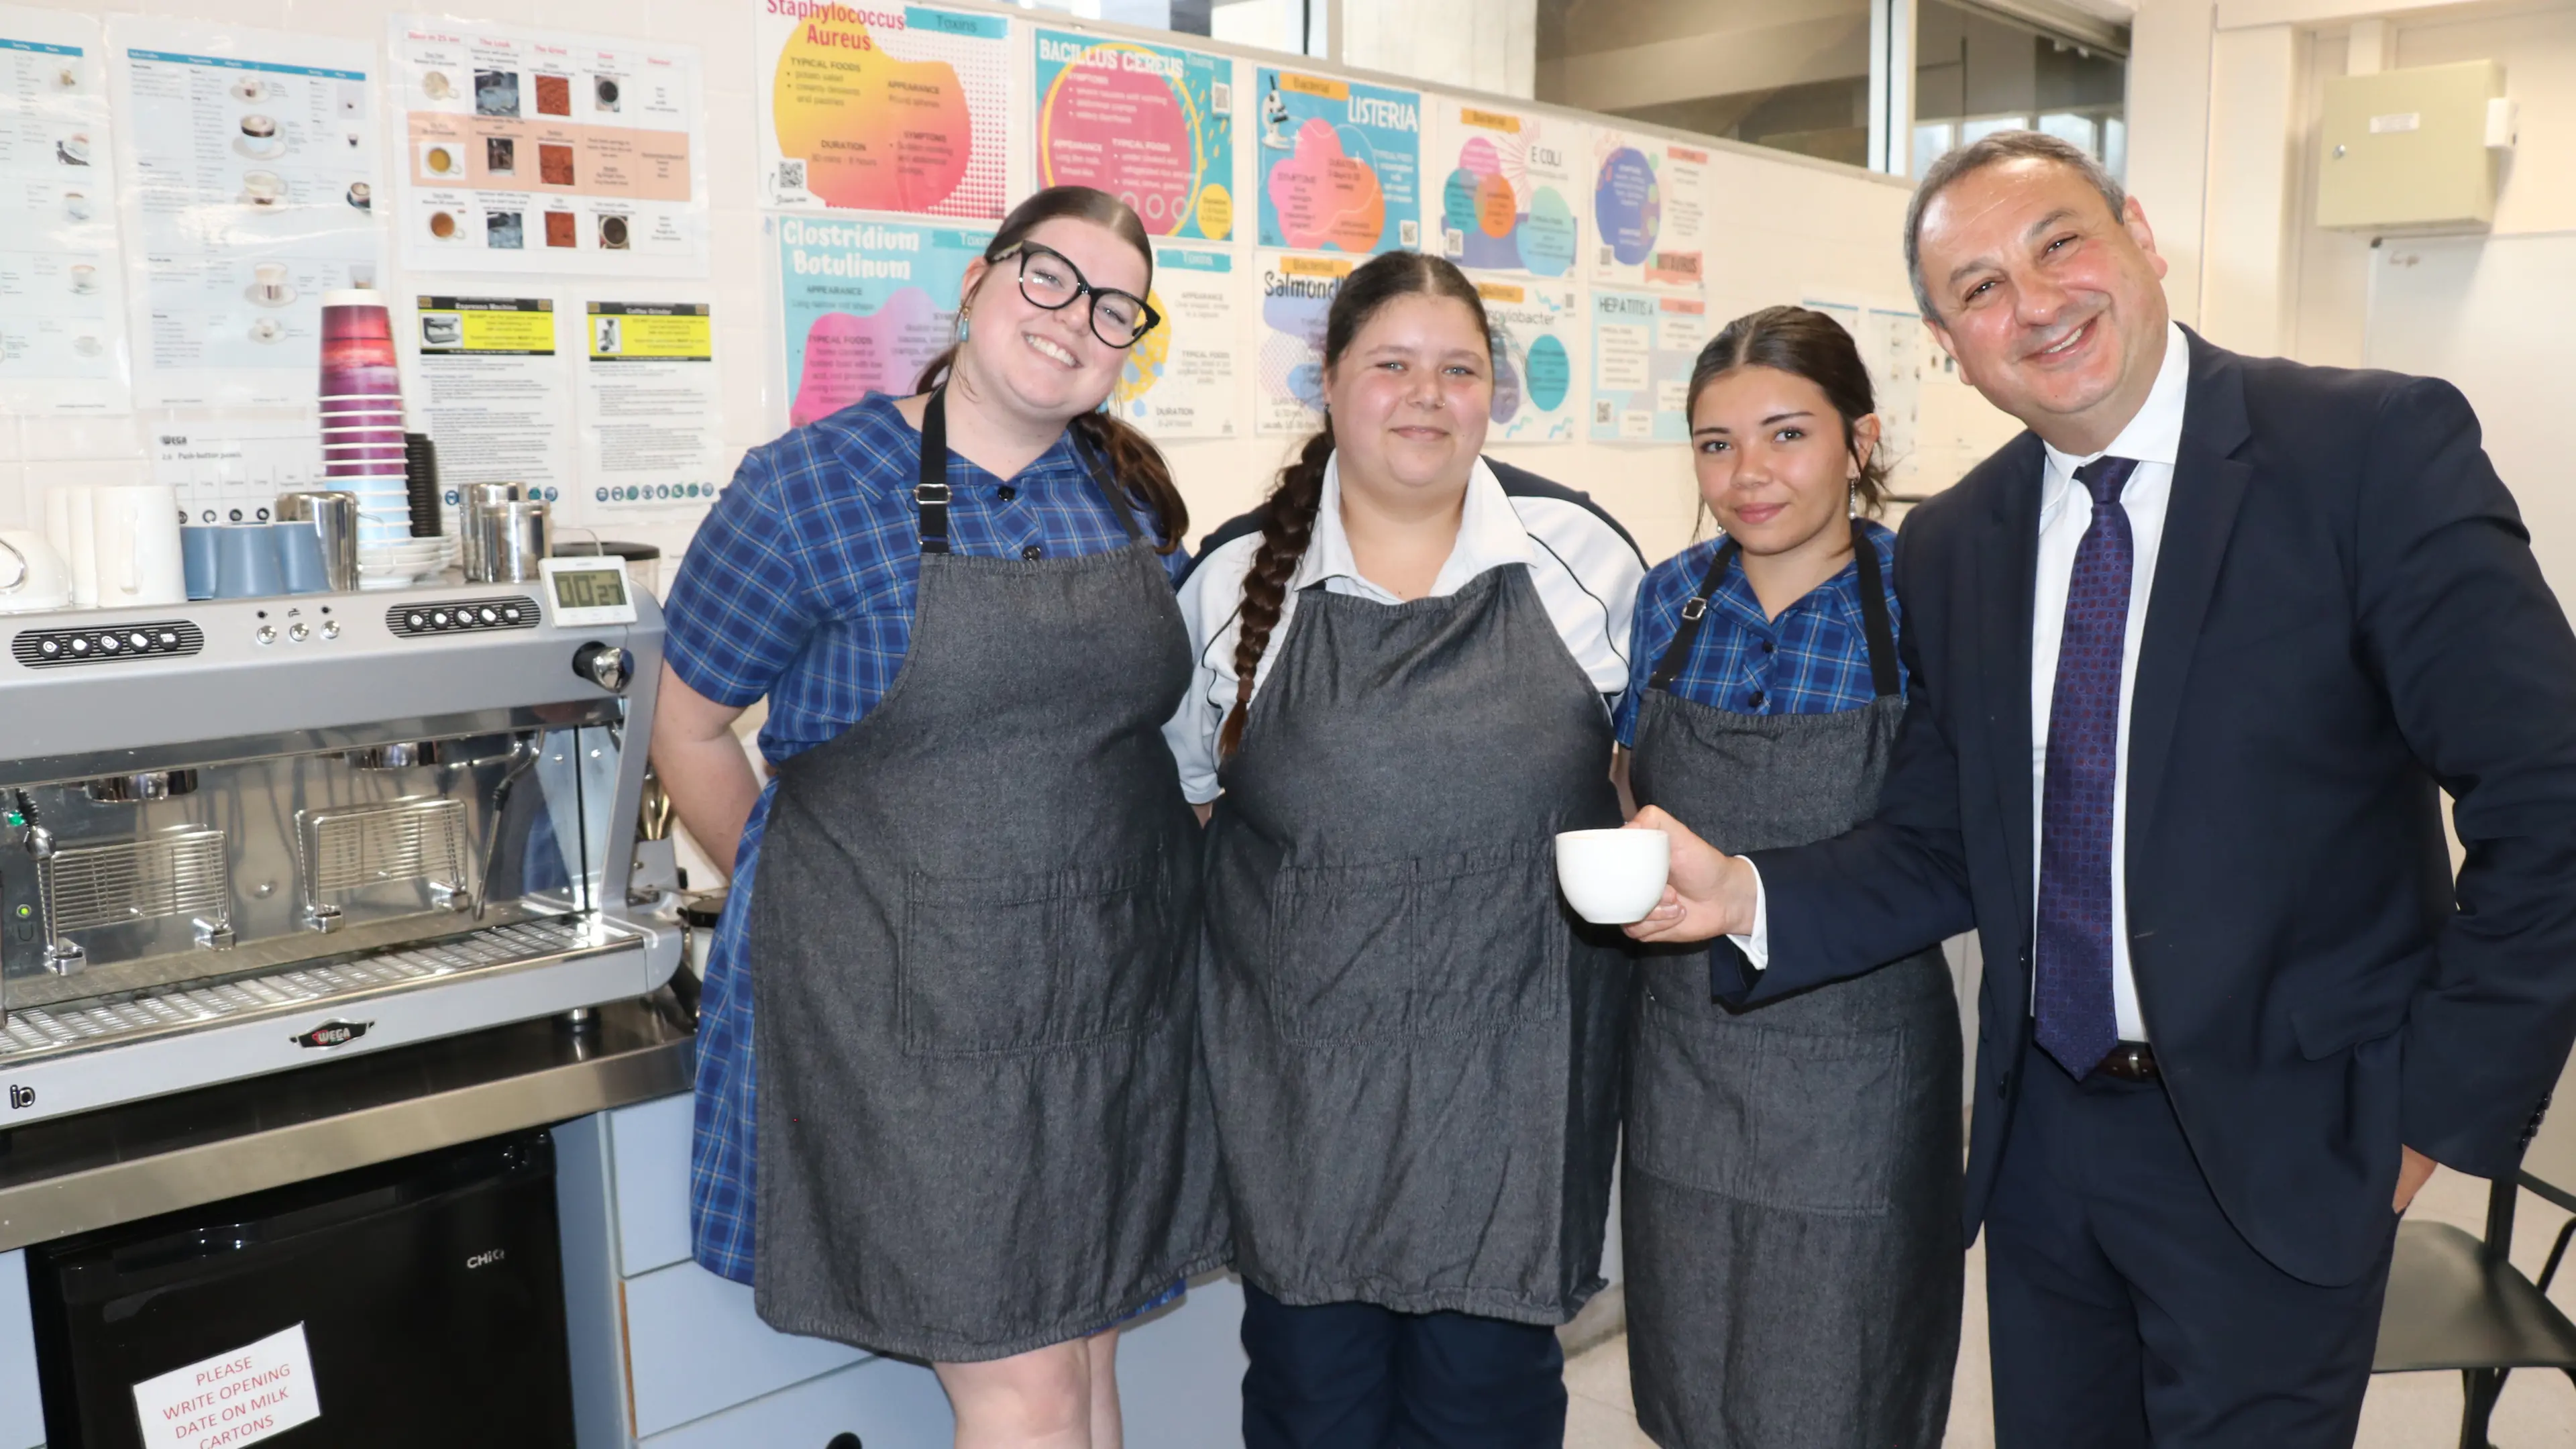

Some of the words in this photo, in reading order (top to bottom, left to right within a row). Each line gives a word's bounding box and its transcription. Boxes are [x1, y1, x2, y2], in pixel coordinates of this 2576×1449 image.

[767, 0, 905, 30] Staphylococcus
[936, 14, 977, 33] Toxins
[807, 24, 871, 51] Aureus
[790, 57, 827, 70] TYPICAL
[830, 60, 861, 72] FOODS
[1040, 38, 1118, 70] BACILLUS
[1123, 52, 1184, 78] CEREUS
[888, 80, 941, 95] APPEARANCE
[1348, 95, 1418, 133] LISTERIA
[821, 139, 866, 152] DURATION
[1531, 146, 1538, 164] E
[1540, 148, 1562, 167] COLI
[783, 221, 919, 252] Clostridium
[959, 231, 993, 248] Toxin
[793, 249, 911, 280] Botulinum
[806, 284, 863, 297] APPEARANCE
[1265, 270, 1344, 301] Salmonel
[1598, 297, 1648, 315] HEPATITIS
[808, 334, 842, 345] TYPICAL
[844, 335, 873, 345] FOODS
[319, 1027, 351, 1042] WEGA
[196, 1356, 253, 1386] PLEASE
[162, 1391, 215, 1420] WRITE
[219, 1364, 291, 1400] OPENING
[175, 1413, 218, 1439] DATE
[221, 1403, 246, 1421] ON
[251, 1387, 289, 1411] MILK
[199, 1415, 274, 1449] CARTONS
